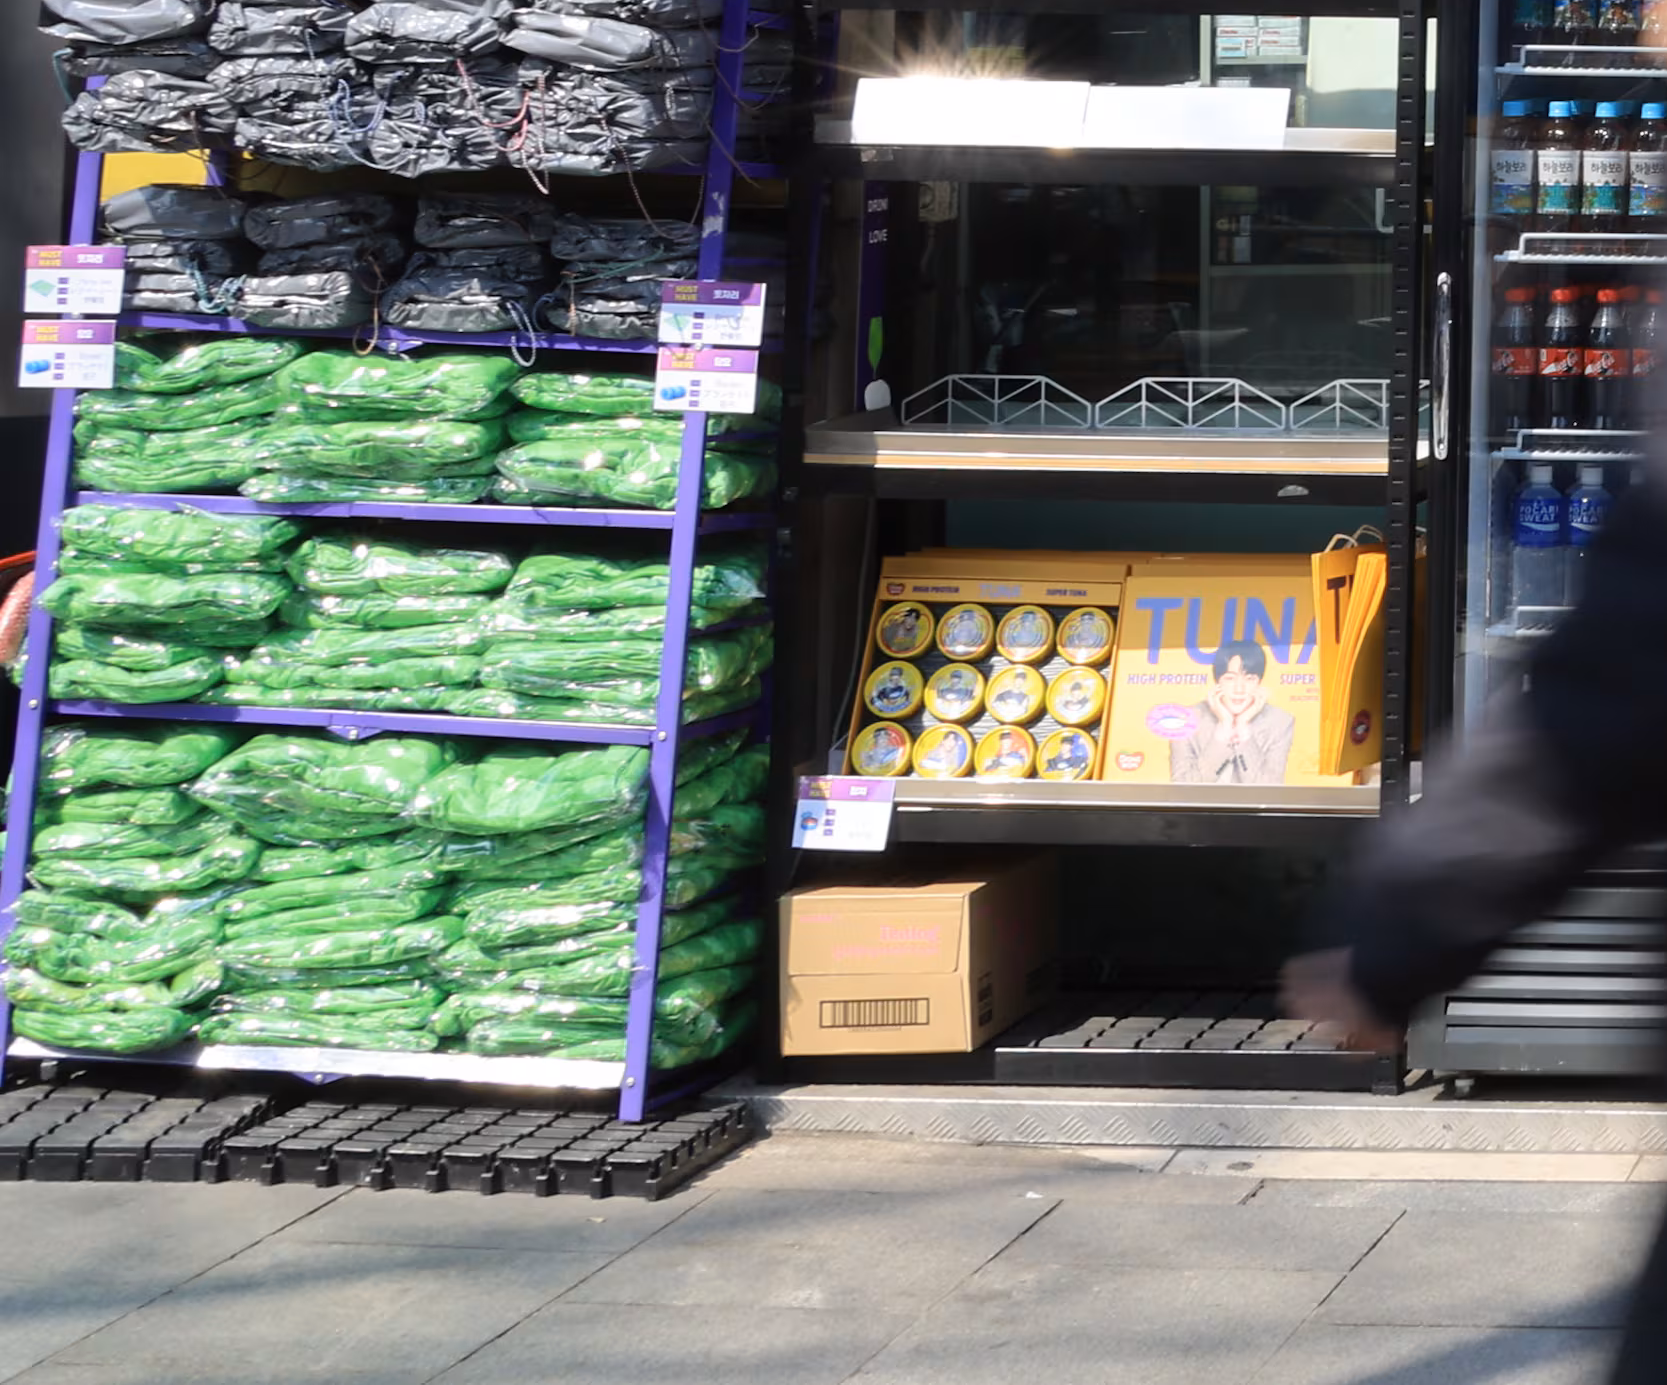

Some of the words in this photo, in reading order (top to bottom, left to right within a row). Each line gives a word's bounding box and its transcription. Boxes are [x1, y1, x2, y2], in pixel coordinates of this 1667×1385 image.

[1128, 674, 1156, 685] HIGH
[1159, 674, 1208, 685] PROTEIN
[1280, 674, 1316, 685] SUPER
